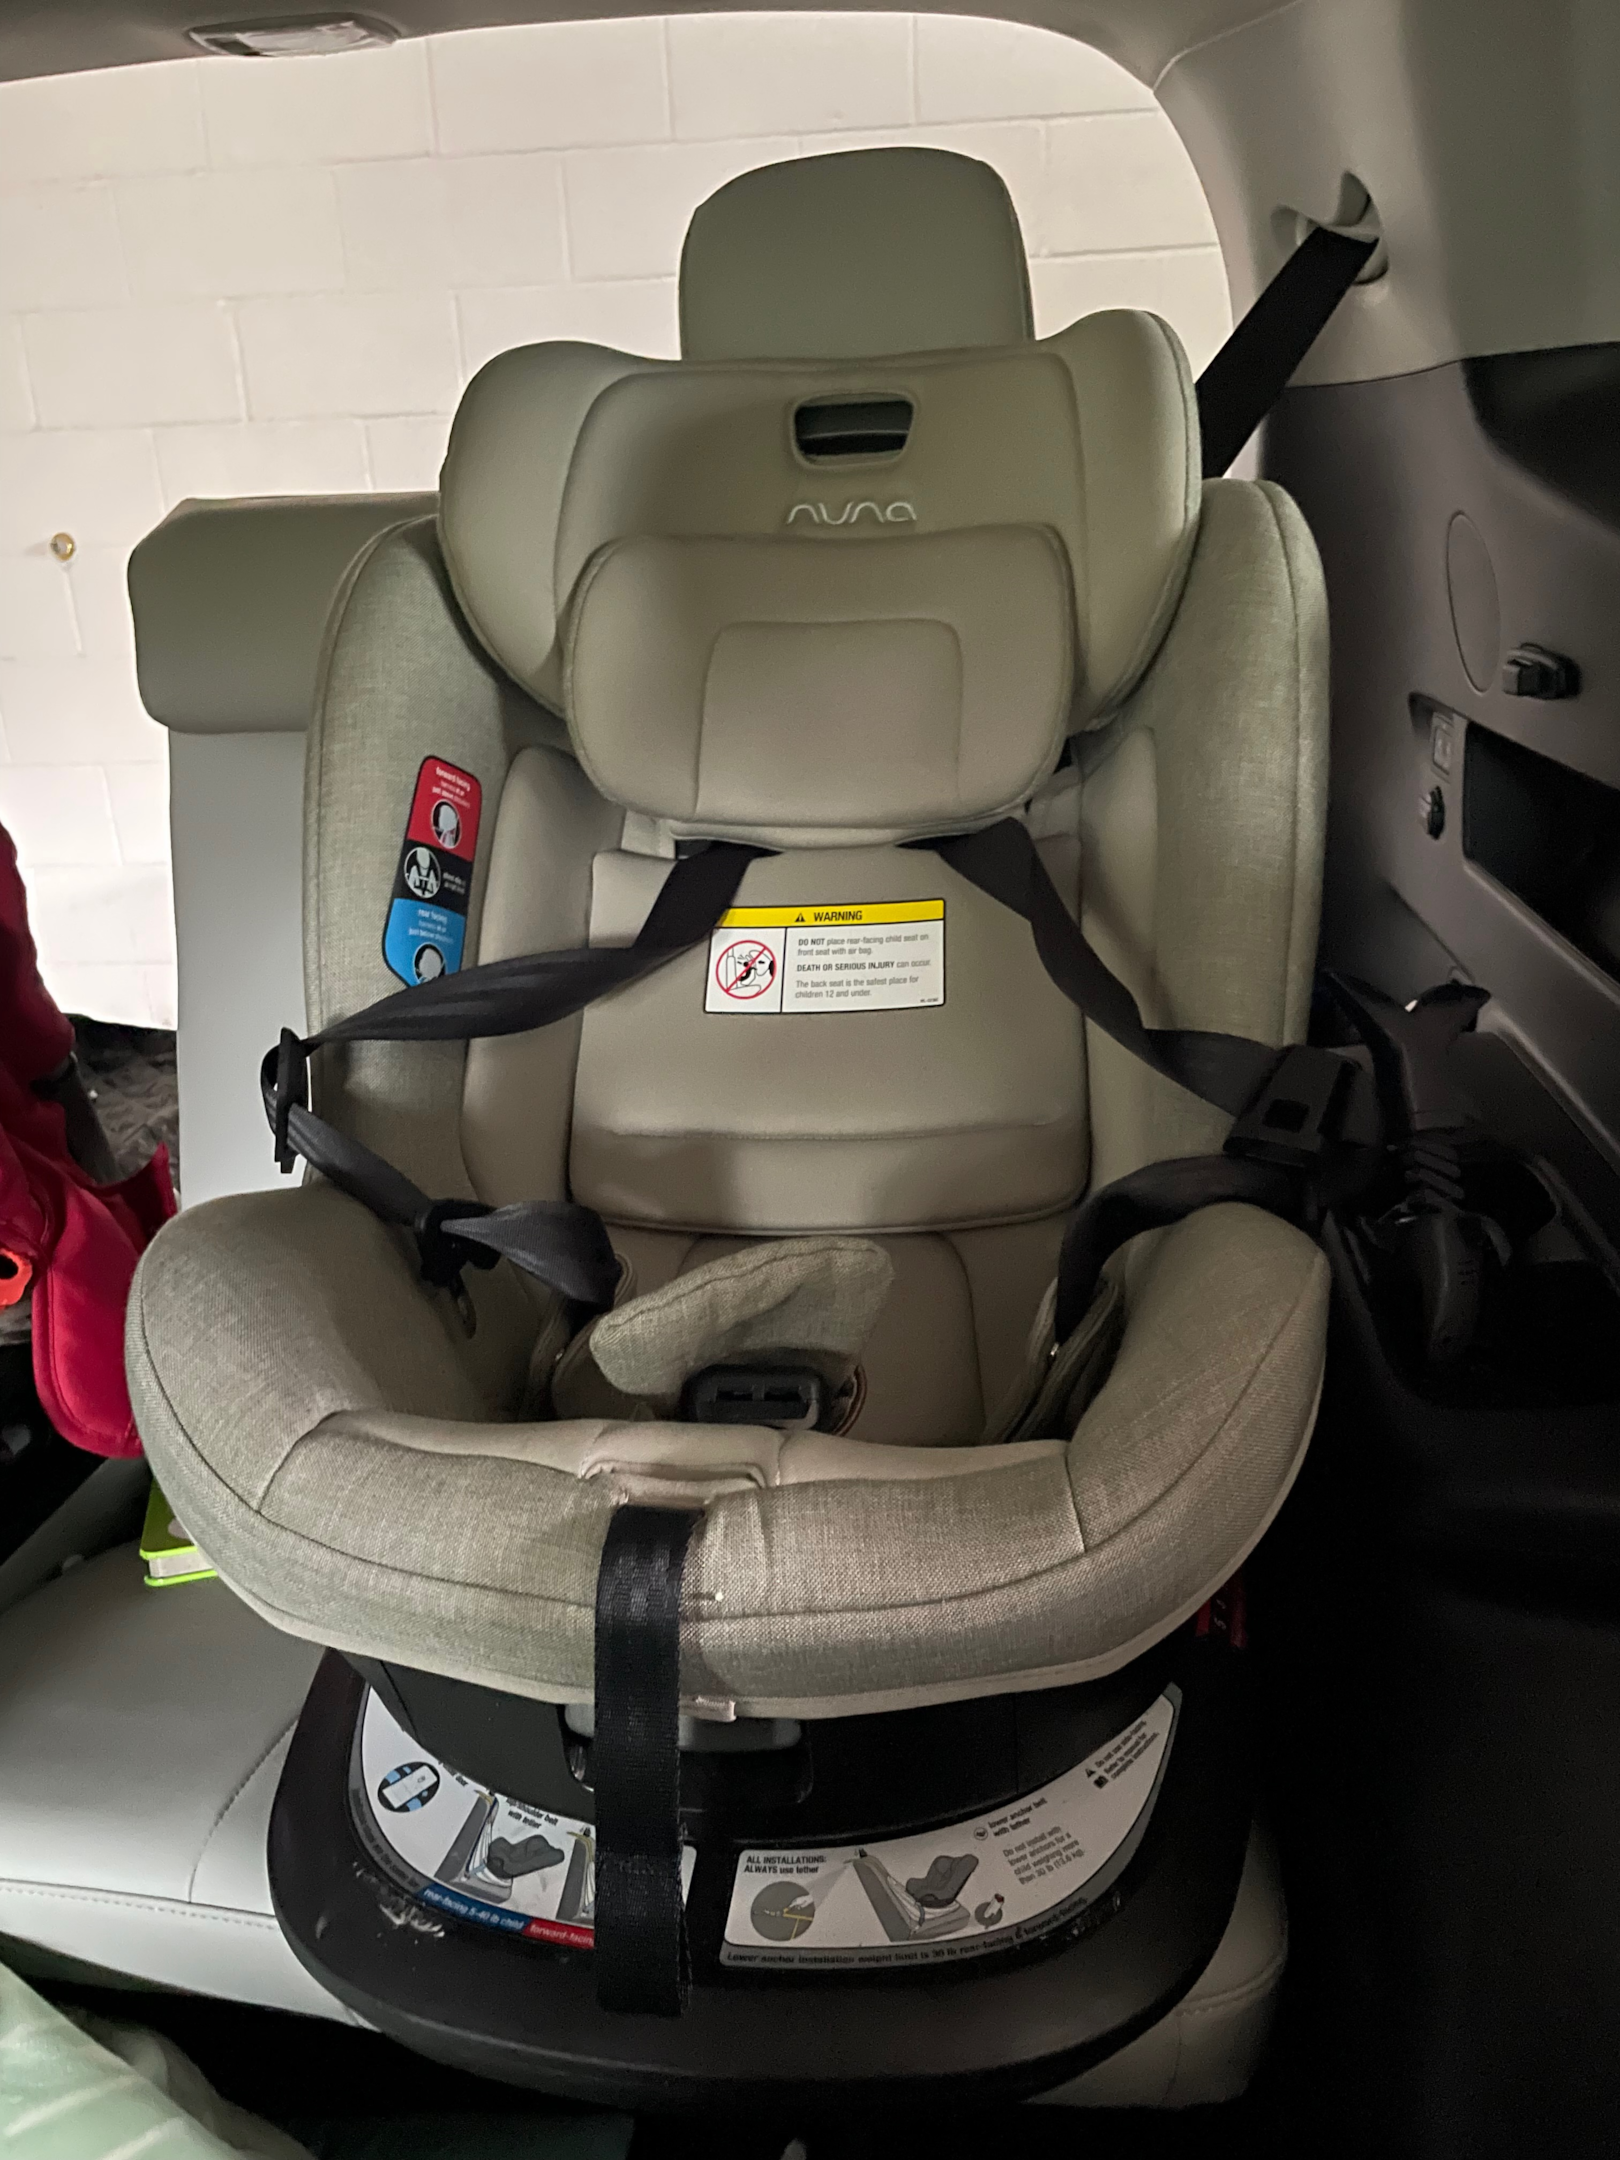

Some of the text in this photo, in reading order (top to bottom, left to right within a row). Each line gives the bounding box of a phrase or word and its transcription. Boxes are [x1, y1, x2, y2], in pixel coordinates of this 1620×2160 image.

[787, 501, 917, 525] nuna
[813, 910, 863, 922] WARNING
[798, 938, 809, 946] DO
[810, 937, 826, 946] NOT
[826, 937, 845, 947] place
[846, 935, 884, 946] rear-facing
[885, 934, 901, 943] child
[903, 934, 918, 942] seat
[797, 946, 873, 957] front seat with air bag.
[796, 963, 821, 972] DEATH
[822, 963, 833, 972] OR
[834, 962, 866, 971] SERIOUS
[867, 960, 895, 970] INJURY
[911, 959, 931, 967] occur.
[796, 975, 919, 988] The back seat is the safest place for
[795, 988, 872, 999] children 12 and under.
[987, 1816, 1009, 1829] lower
[1009, 1804, 1033, 1820] anchor
[993, 1817, 1031, 1837] with tether
[1003, 1826, 1061, 1857] Do not install with
[1008, 1853, 1028, 1866] lower
[1028, 1841, 1056, 1857] anchors
[1054, 1835, 1066, 1844] for
[1013, 1839, 1080, 1875] child weighing more
[746, 1855, 827, 1865] ALL INSTALLATIONS:
[744, 1864, 819, 1874] ALWAYS use tether
[1018, 1873, 1036, 1885] than
[1035, 1867, 1046, 1877] 30
[1045, 1864, 1054, 1873] lb
[423, 1888, 525, 1930] rear-facing 5-40 lb child
[727, 1951, 758, 1962] Lower
